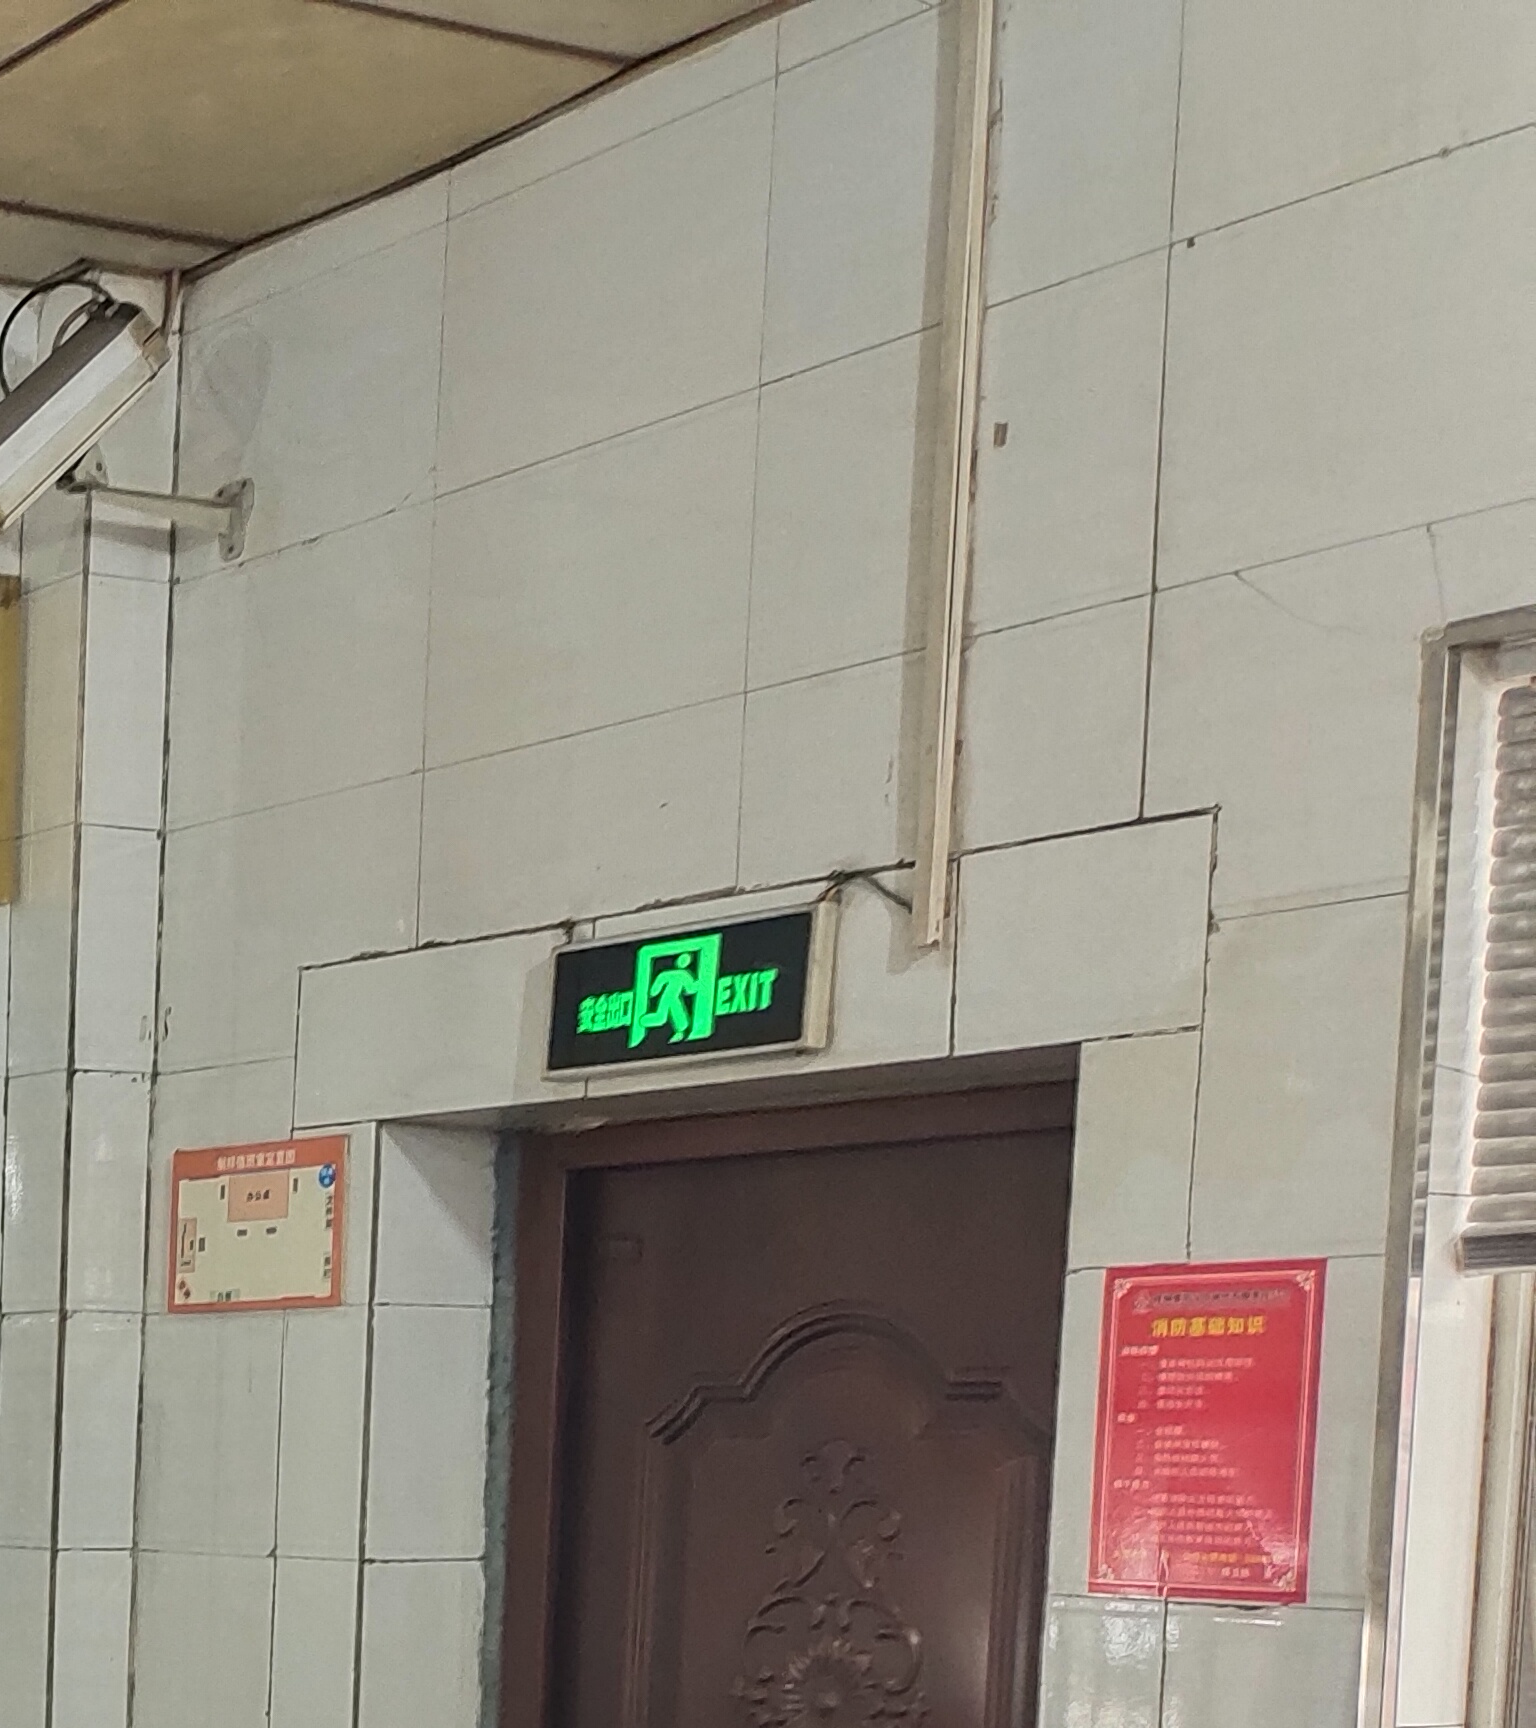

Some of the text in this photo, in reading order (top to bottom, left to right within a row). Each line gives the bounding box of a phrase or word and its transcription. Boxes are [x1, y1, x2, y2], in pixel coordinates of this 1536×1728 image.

[716, 969, 778, 1016] EXIT
[1152, 1316, 1265, 1338] 消防基础知识
